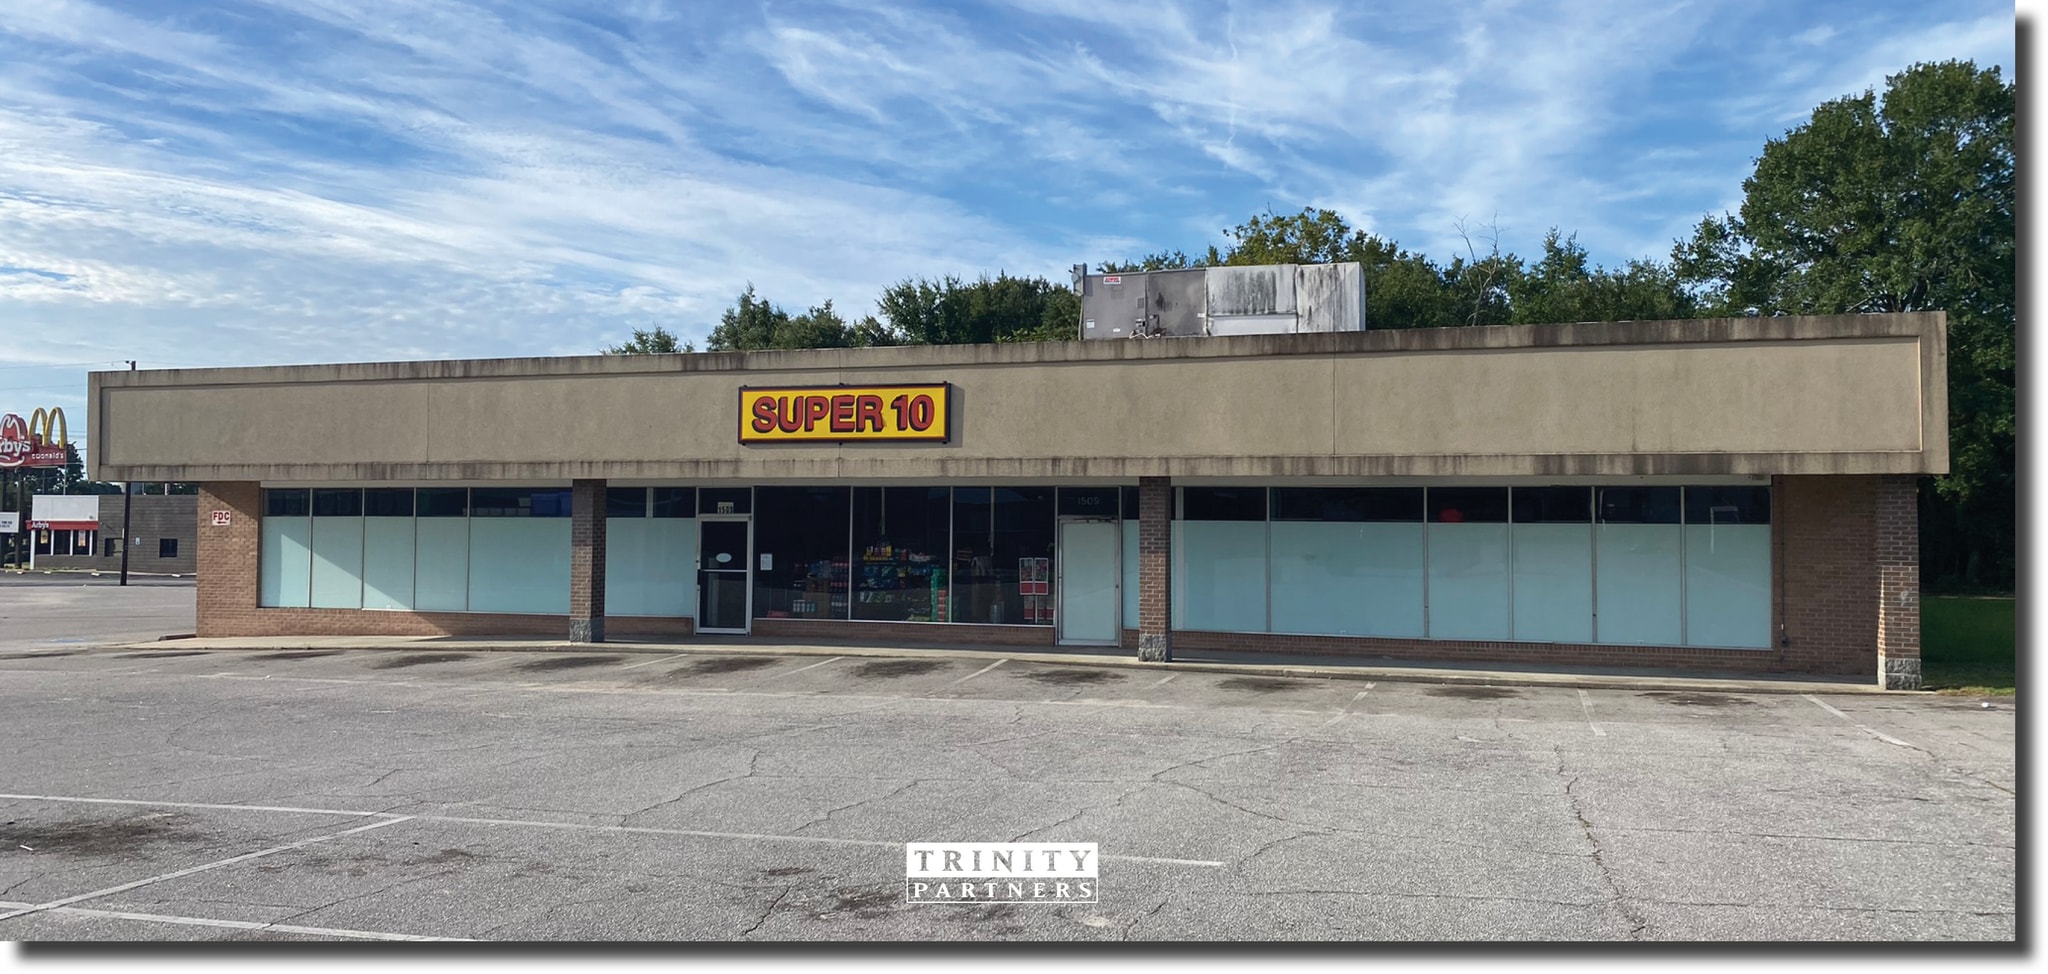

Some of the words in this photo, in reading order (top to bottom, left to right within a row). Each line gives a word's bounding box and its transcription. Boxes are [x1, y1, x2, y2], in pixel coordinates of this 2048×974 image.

[752, 395, 884, 433] SUPER
[891, 394, 935, 431] 10
[0, 435, 31, 457] rby's
[213, 511, 230, 520] FDC
